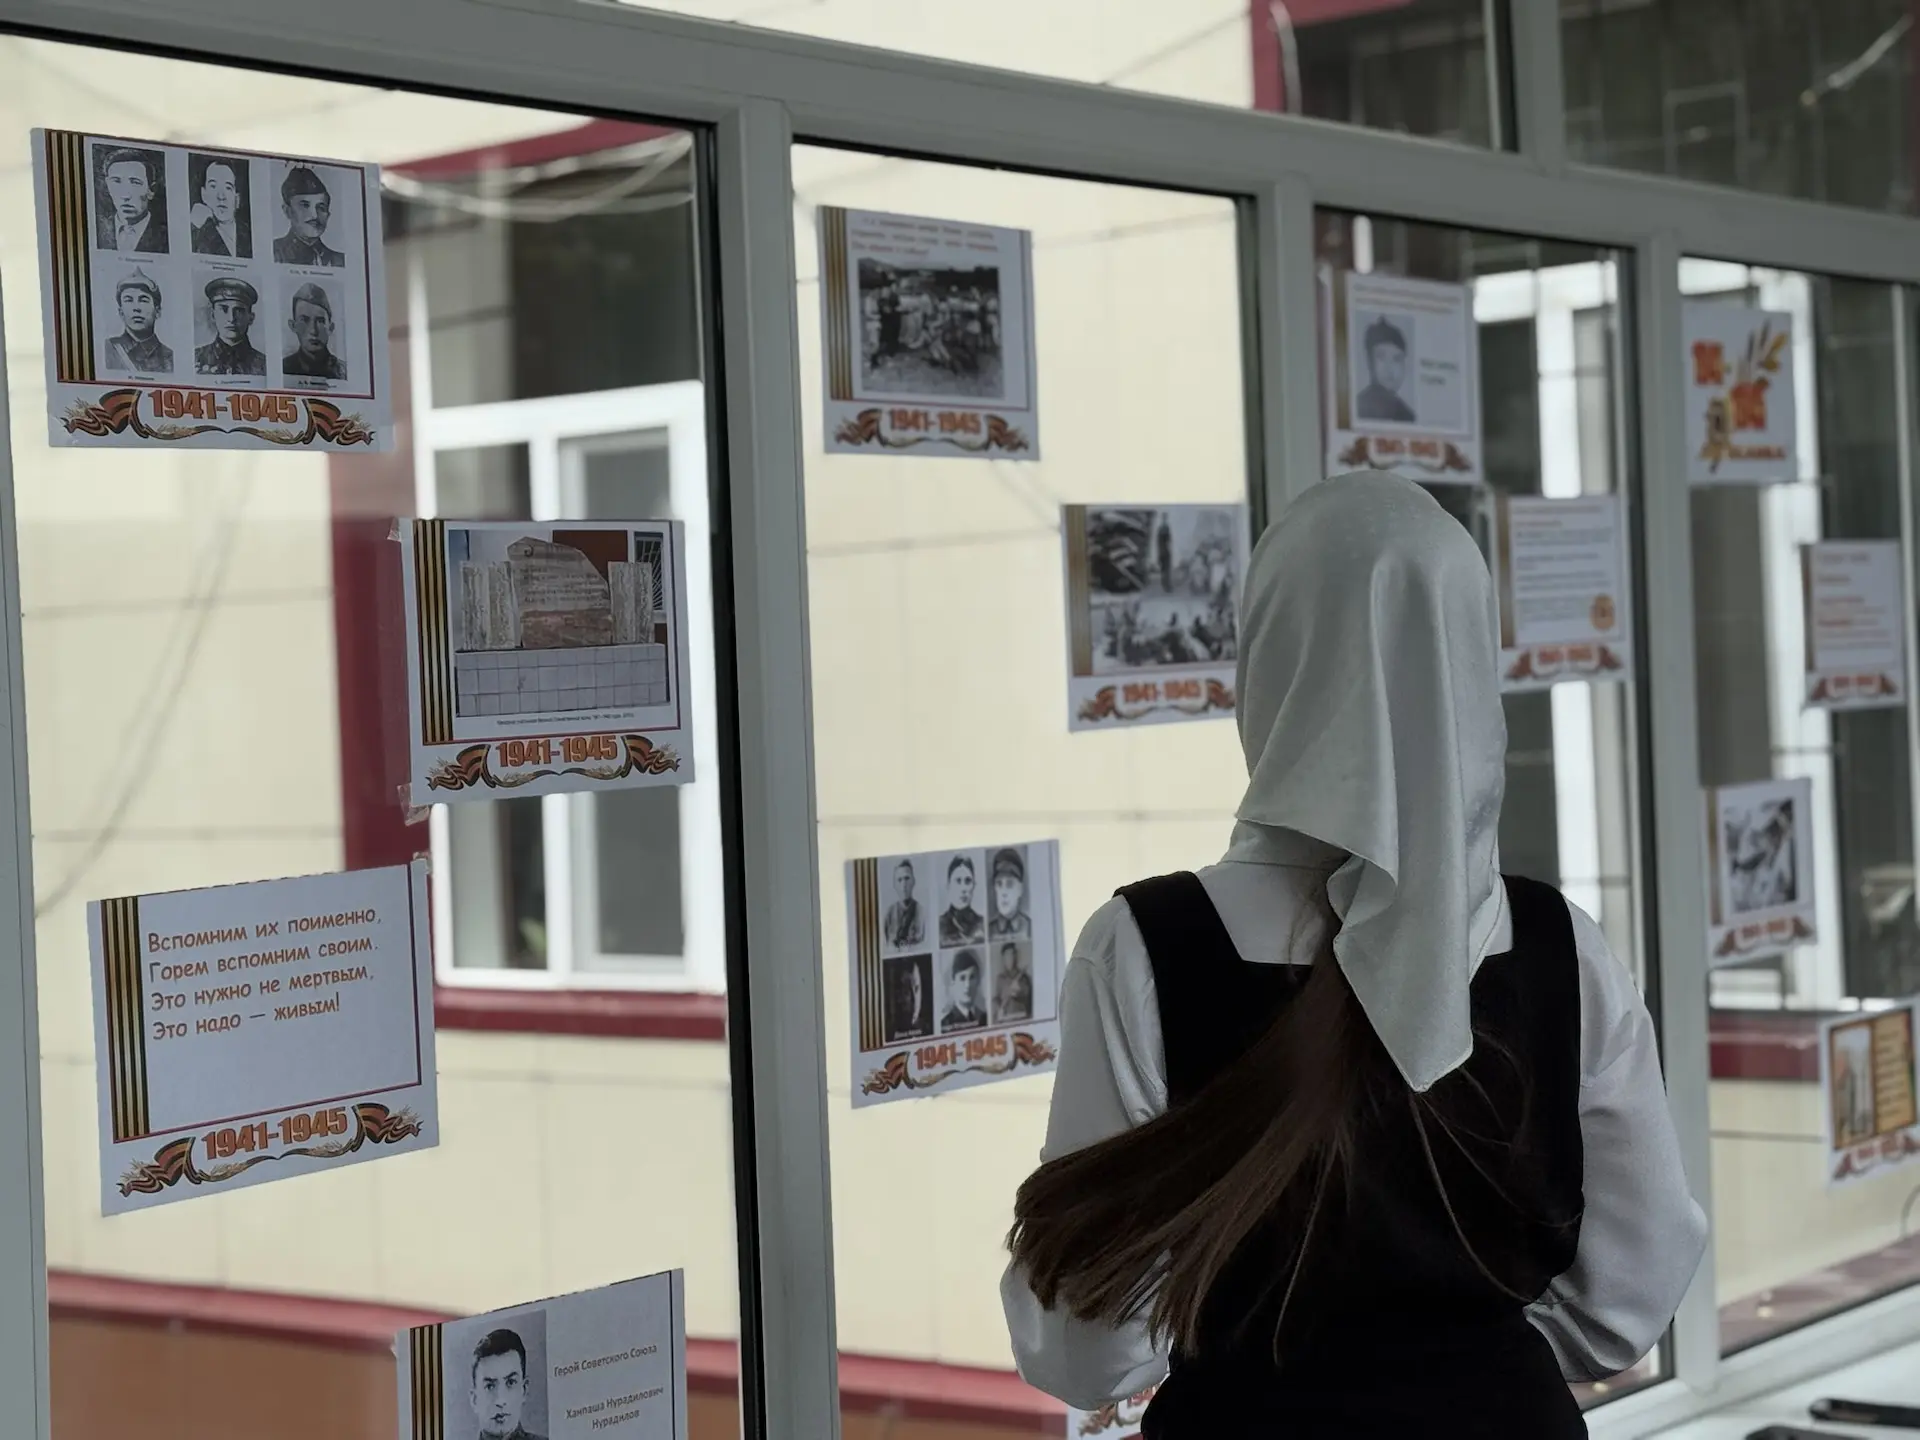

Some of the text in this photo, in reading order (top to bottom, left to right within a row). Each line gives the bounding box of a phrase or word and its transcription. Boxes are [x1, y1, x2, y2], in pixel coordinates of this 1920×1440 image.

[147, 389, 299, 424] 1941-1945
[495, 735, 618, 768] 1941-1945
[148, 908, 382, 952] Вспомним их поименно,
[149, 961, 209, 985] Горем
[217, 945, 311, 972] вспомним
[151, 992, 187, 1011] Это
[194, 983, 252, 1008] нужно
[259, 979, 281, 995] не
[153, 1021, 188, 1040] Это
[196, 1014, 241, 1035] надо
[273, 991, 340, 1021] живым!
[914, 1033, 1008, 1071] 1941-1945
[201, 1106, 348, 1160] 1941-1945
[554, 1344, 658, 1378] Герой Советского Союза
[606, 1387, 664, 1408] Нурадилович
[592, 1409, 640, 1430] Нурадилов
